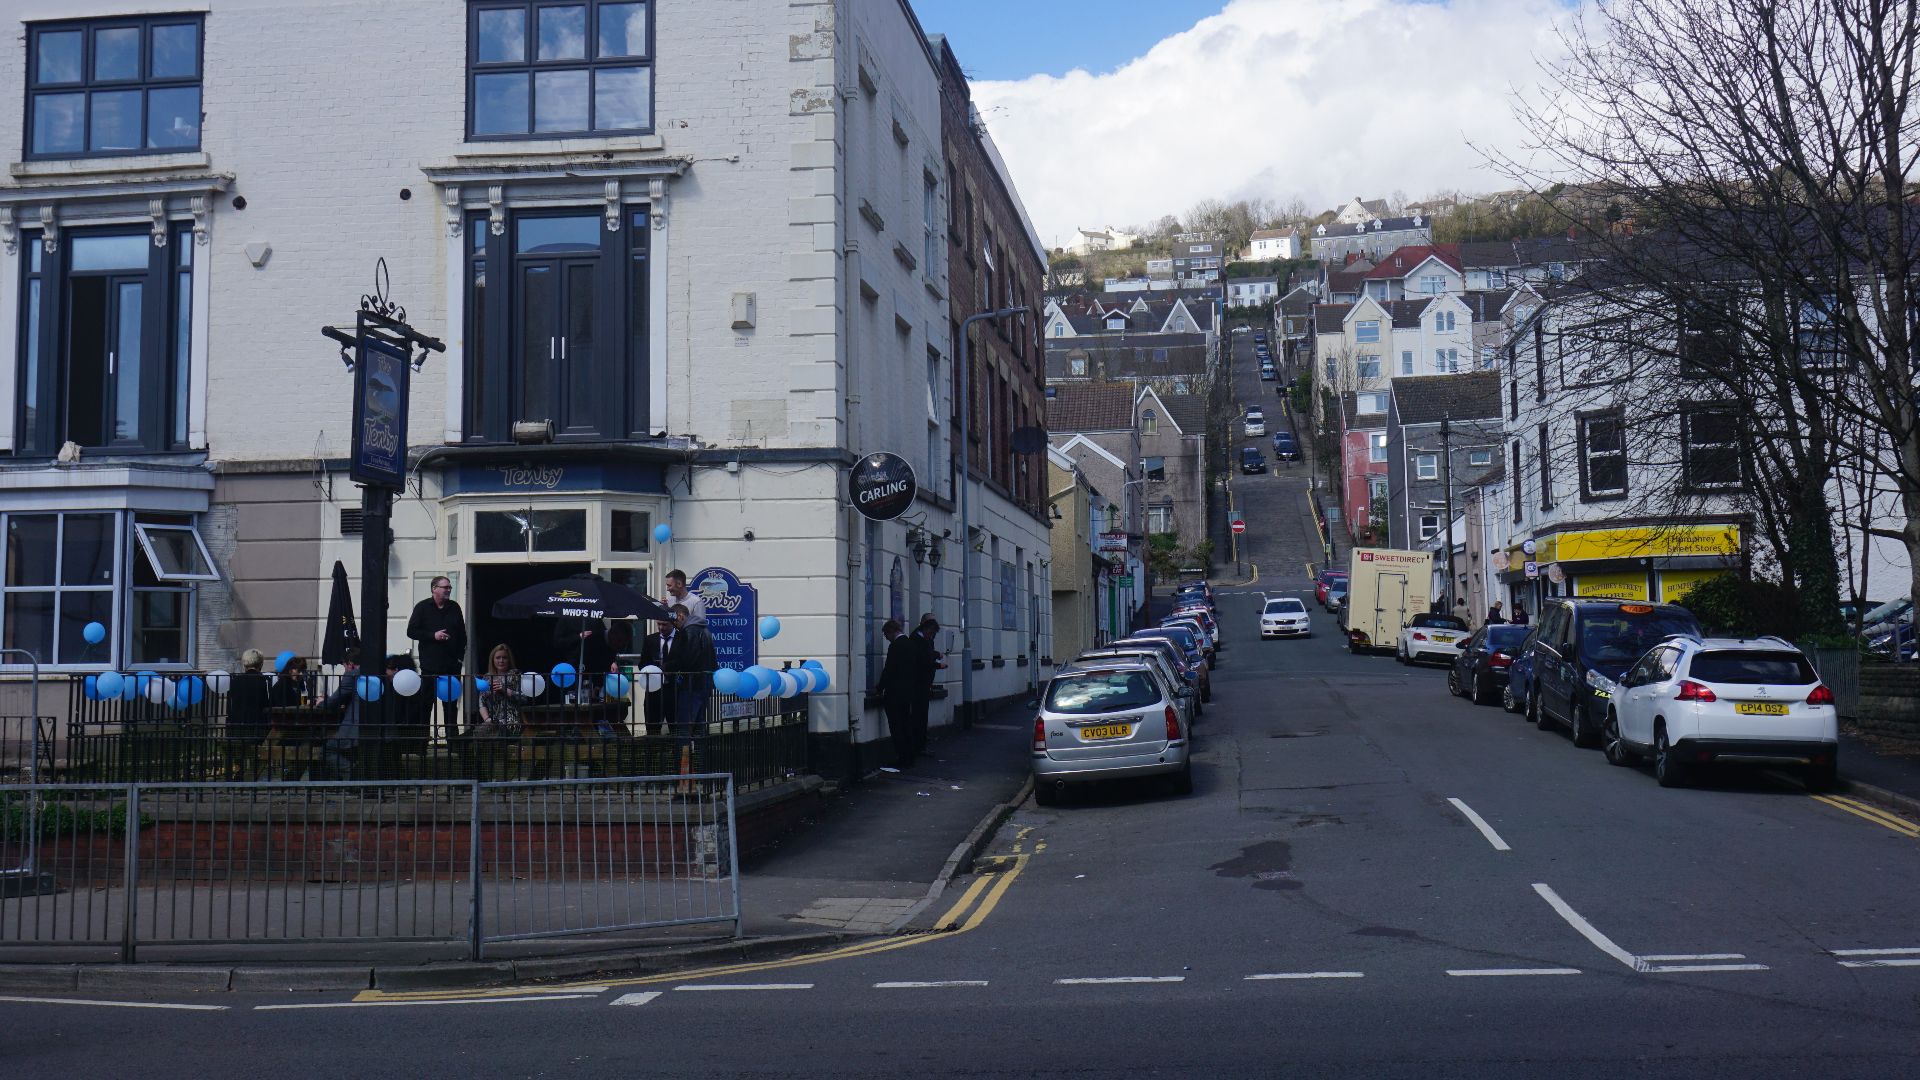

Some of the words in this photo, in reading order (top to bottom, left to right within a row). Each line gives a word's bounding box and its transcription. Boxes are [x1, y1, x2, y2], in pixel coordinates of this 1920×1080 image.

[364, 417, 399, 457] Tenby
[498, 463, 564, 489] Tenby
[859, 479, 907, 504] CARLING
[1671, 535, 1716, 544] Humphrey
[1695, 544, 1722, 552] Stores
[1374, 554, 1426, 564] SWEETDIRECT
[547, 596, 598, 604] STRONGBOW
[562, 608, 589, 617] WHO'S
[590, 609, 604, 619] IN?
[711, 618, 748, 627] SERVED
[711, 632, 743, 641] MUSIC
[715, 646, 743, 655] TABLE
[717, 661, 744, 670] ORTS
[1741, 703, 1763, 712] CP14
[1083, 727, 1108, 738] CV03
[1109, 725, 1128, 736] ULR
